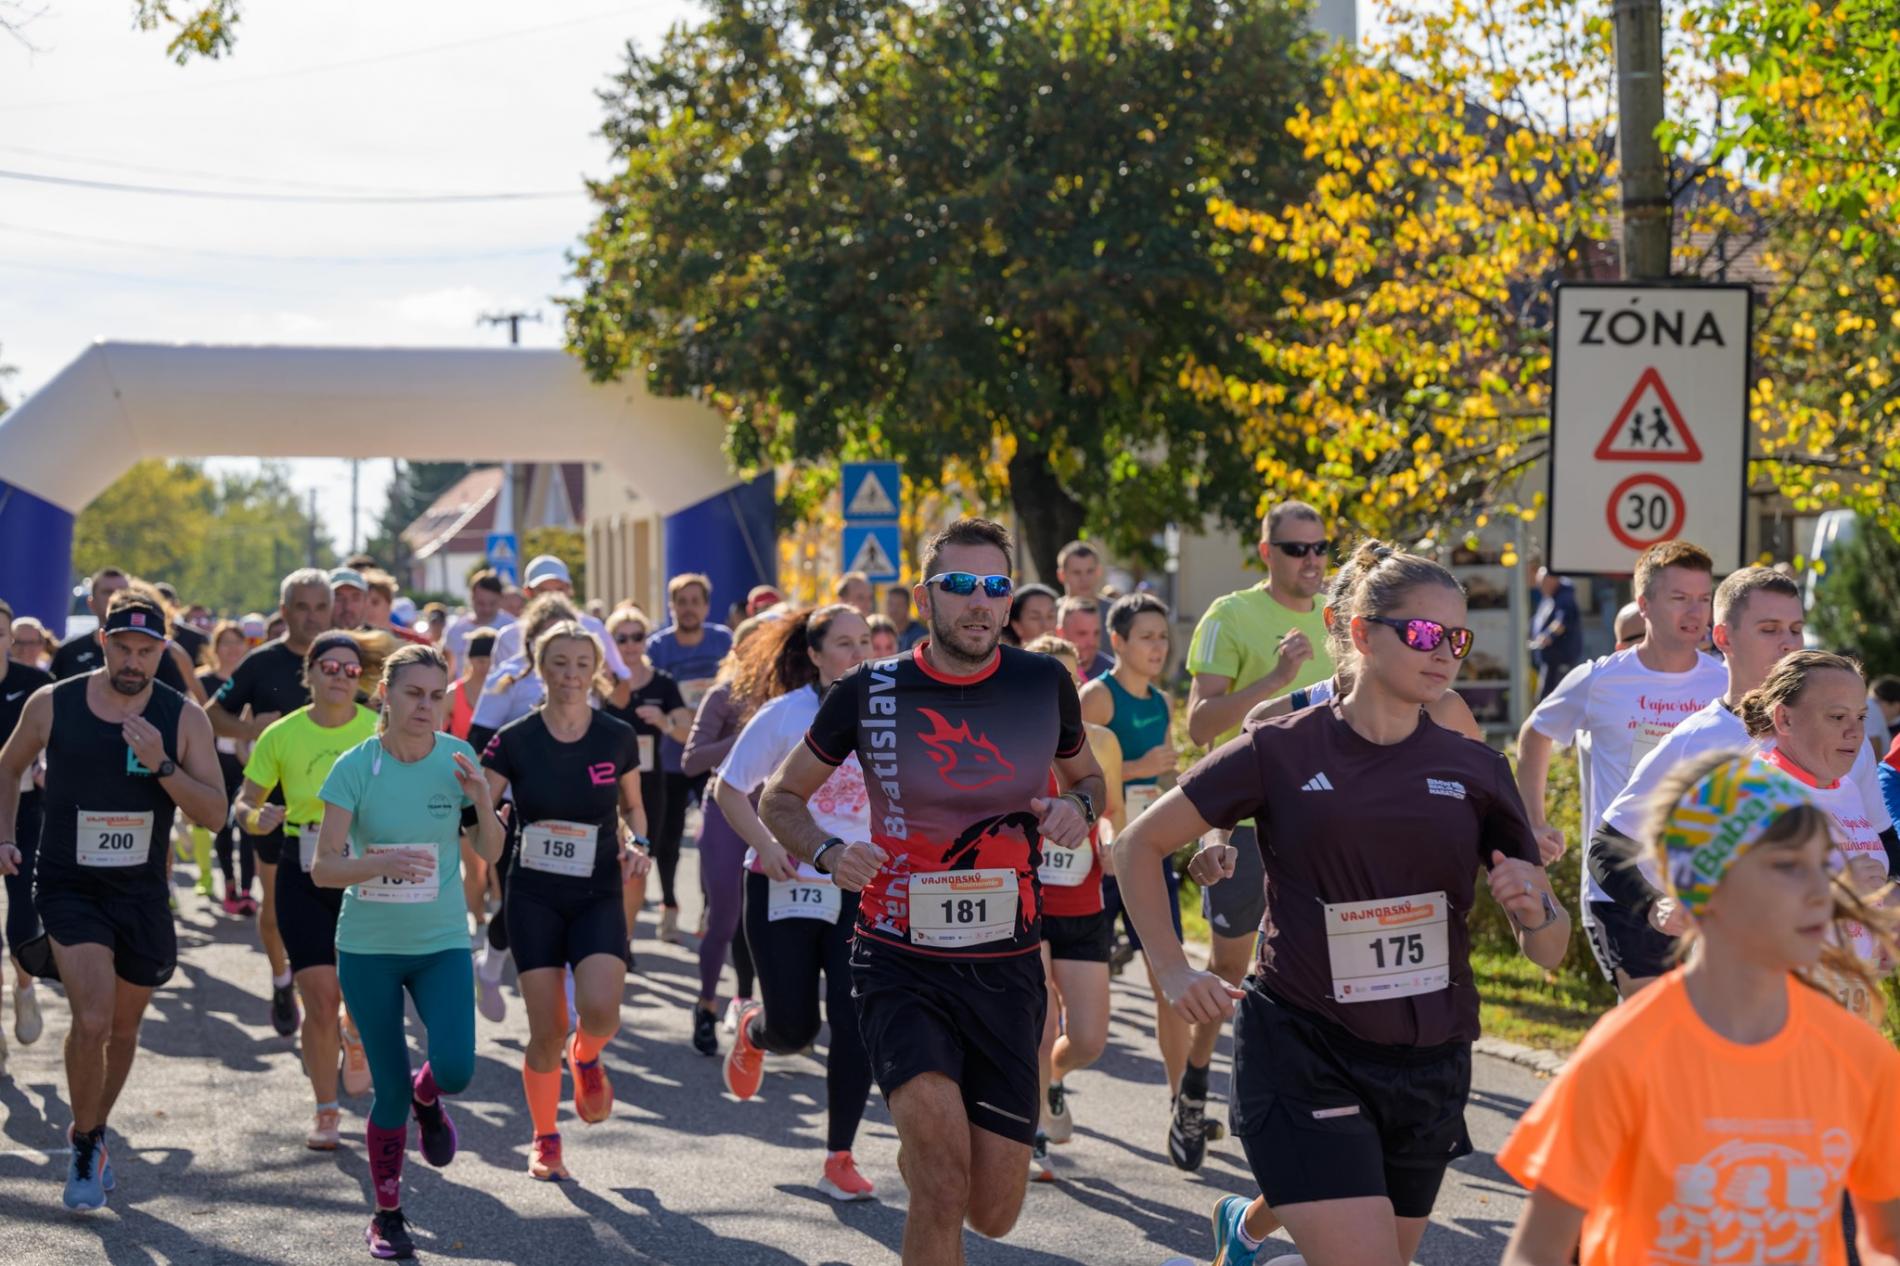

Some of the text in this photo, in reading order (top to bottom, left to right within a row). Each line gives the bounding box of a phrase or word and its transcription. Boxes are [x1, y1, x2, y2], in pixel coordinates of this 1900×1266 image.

[1578, 298, 1725, 346] ZÓNA
[1626, 494, 1667, 531] 30
[860, 658, 908, 840] Bratislava
[98, 832, 134, 850] 200
[542, 839, 576, 859] 158
[1043, 851, 1075, 869] 197
[789, 888, 823, 904] 173
[940, 898, 987, 924] 181
[1368, 933, 1424, 969] 175
